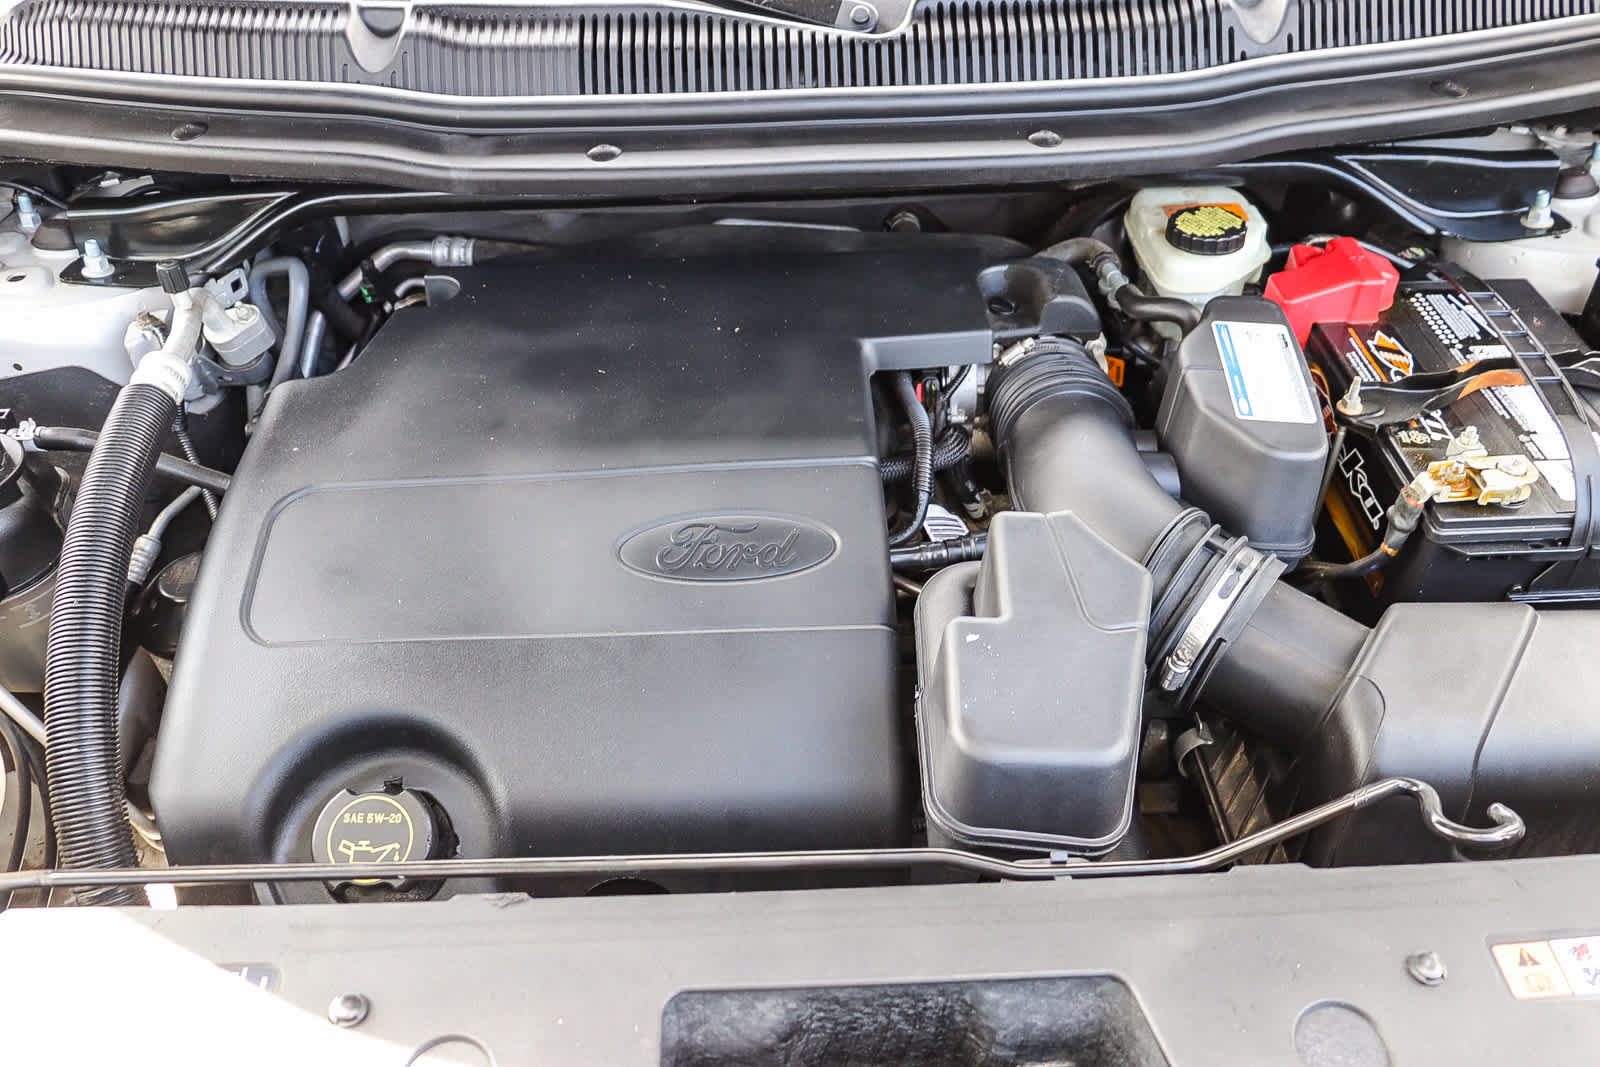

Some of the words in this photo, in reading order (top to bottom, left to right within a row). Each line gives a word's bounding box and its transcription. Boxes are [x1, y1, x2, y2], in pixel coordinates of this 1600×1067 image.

[656, 523, 800, 572] Ford
[344, 813, 364, 823] SAE
[367, 813, 401, 823] 5W-20
